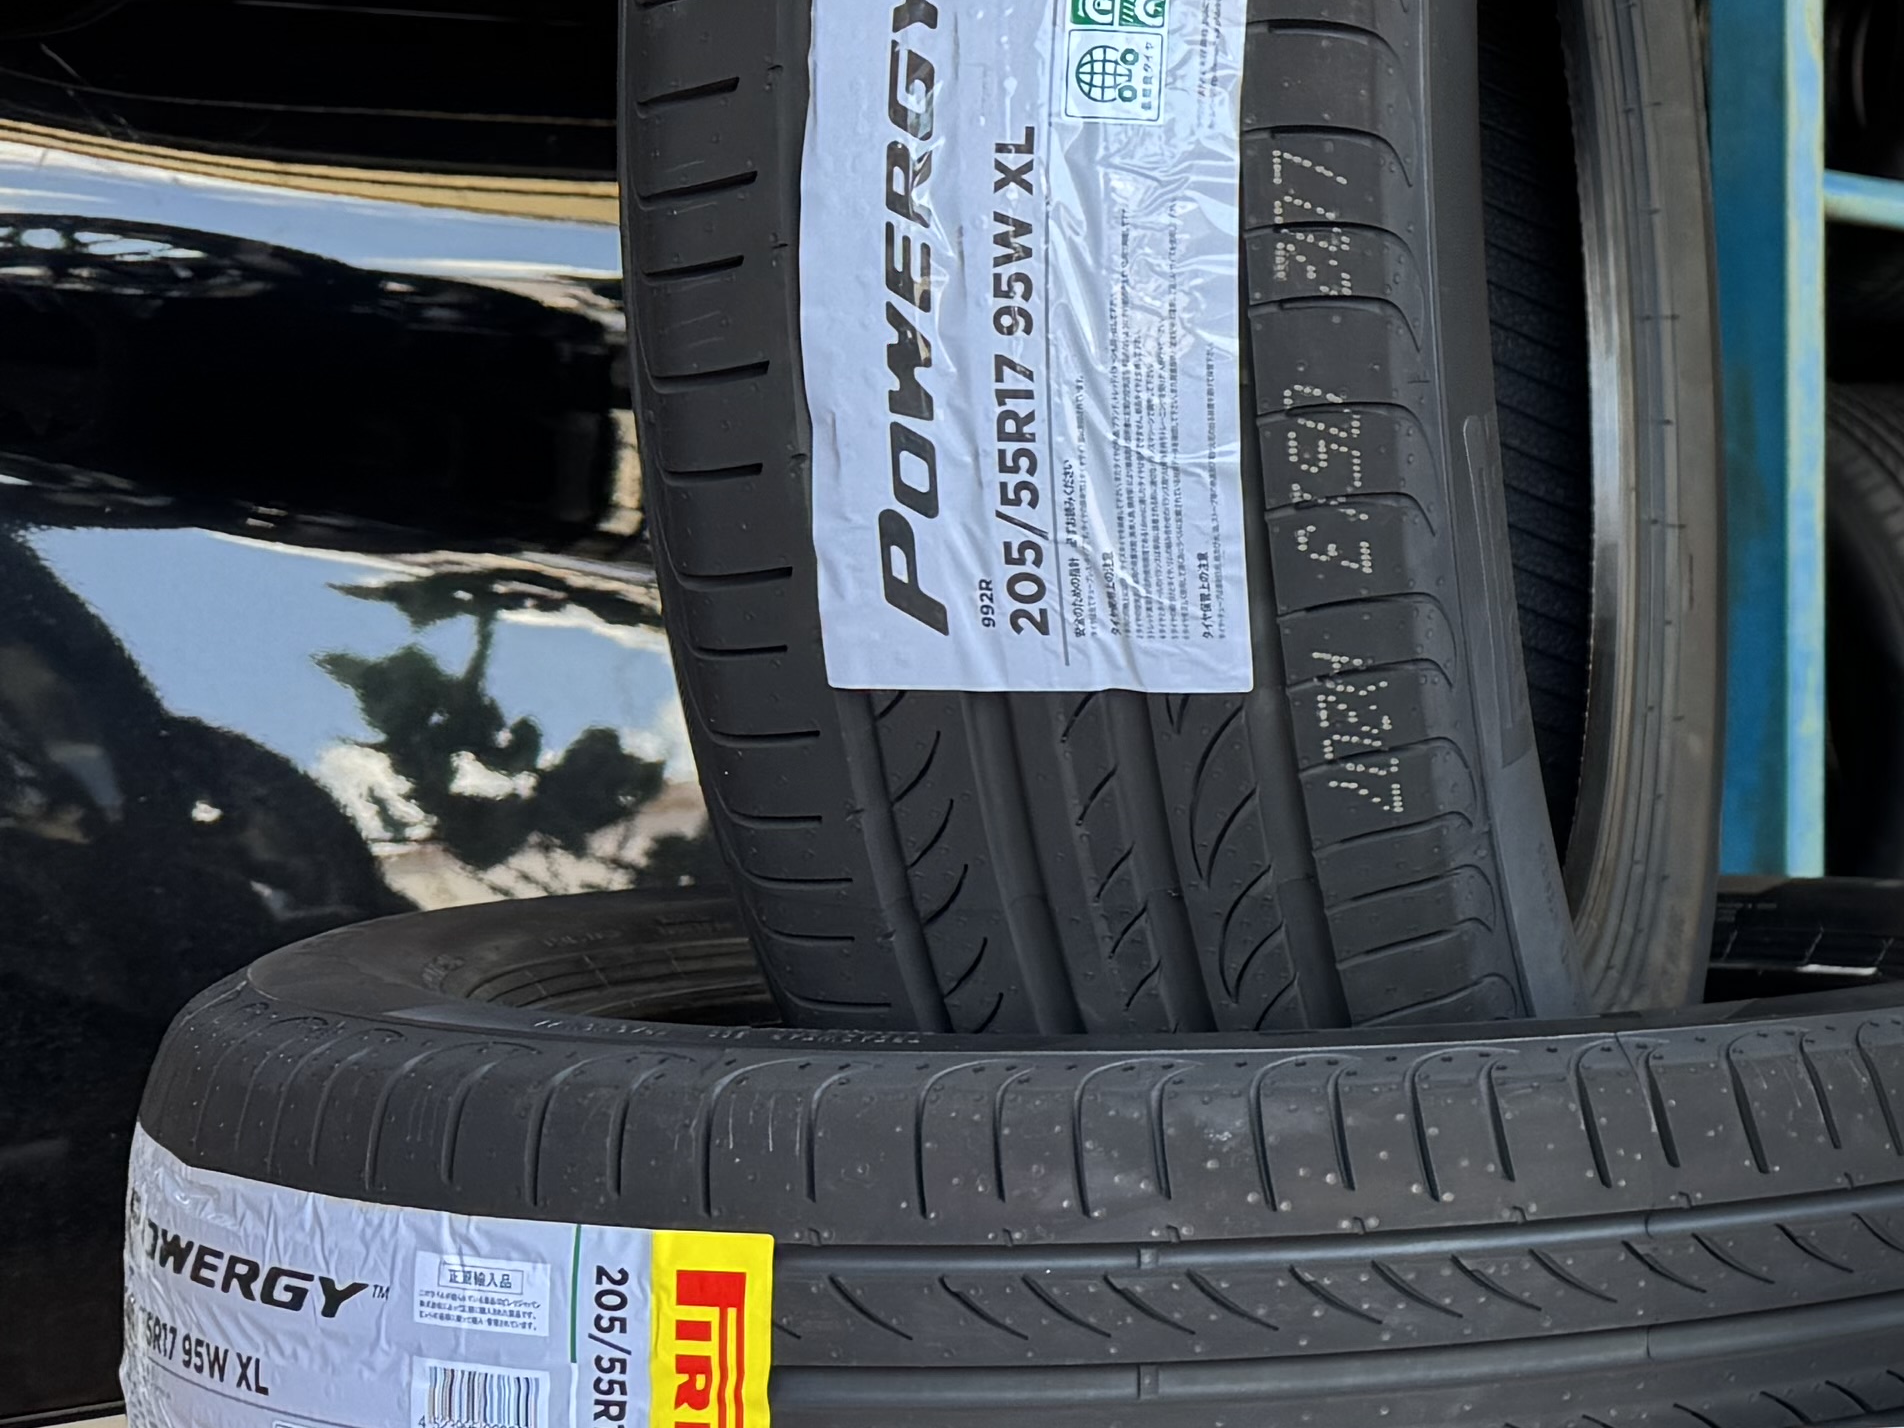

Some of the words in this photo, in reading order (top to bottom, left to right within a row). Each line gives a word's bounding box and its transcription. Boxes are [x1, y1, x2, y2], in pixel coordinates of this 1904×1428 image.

[993, 125, 1034, 194] XL
[993, 212, 1035, 335] 95W
[996, 356, 1049, 636] 205/55R17
[982, 579, 996, 627] 992R
[1200, 552, 1213, 638] タイヤ保管上の注意
[130, 1190, 368, 1318] OWERGY
[183, 1333, 229, 1383] 95W
[237, 1352, 269, 1395] XL
